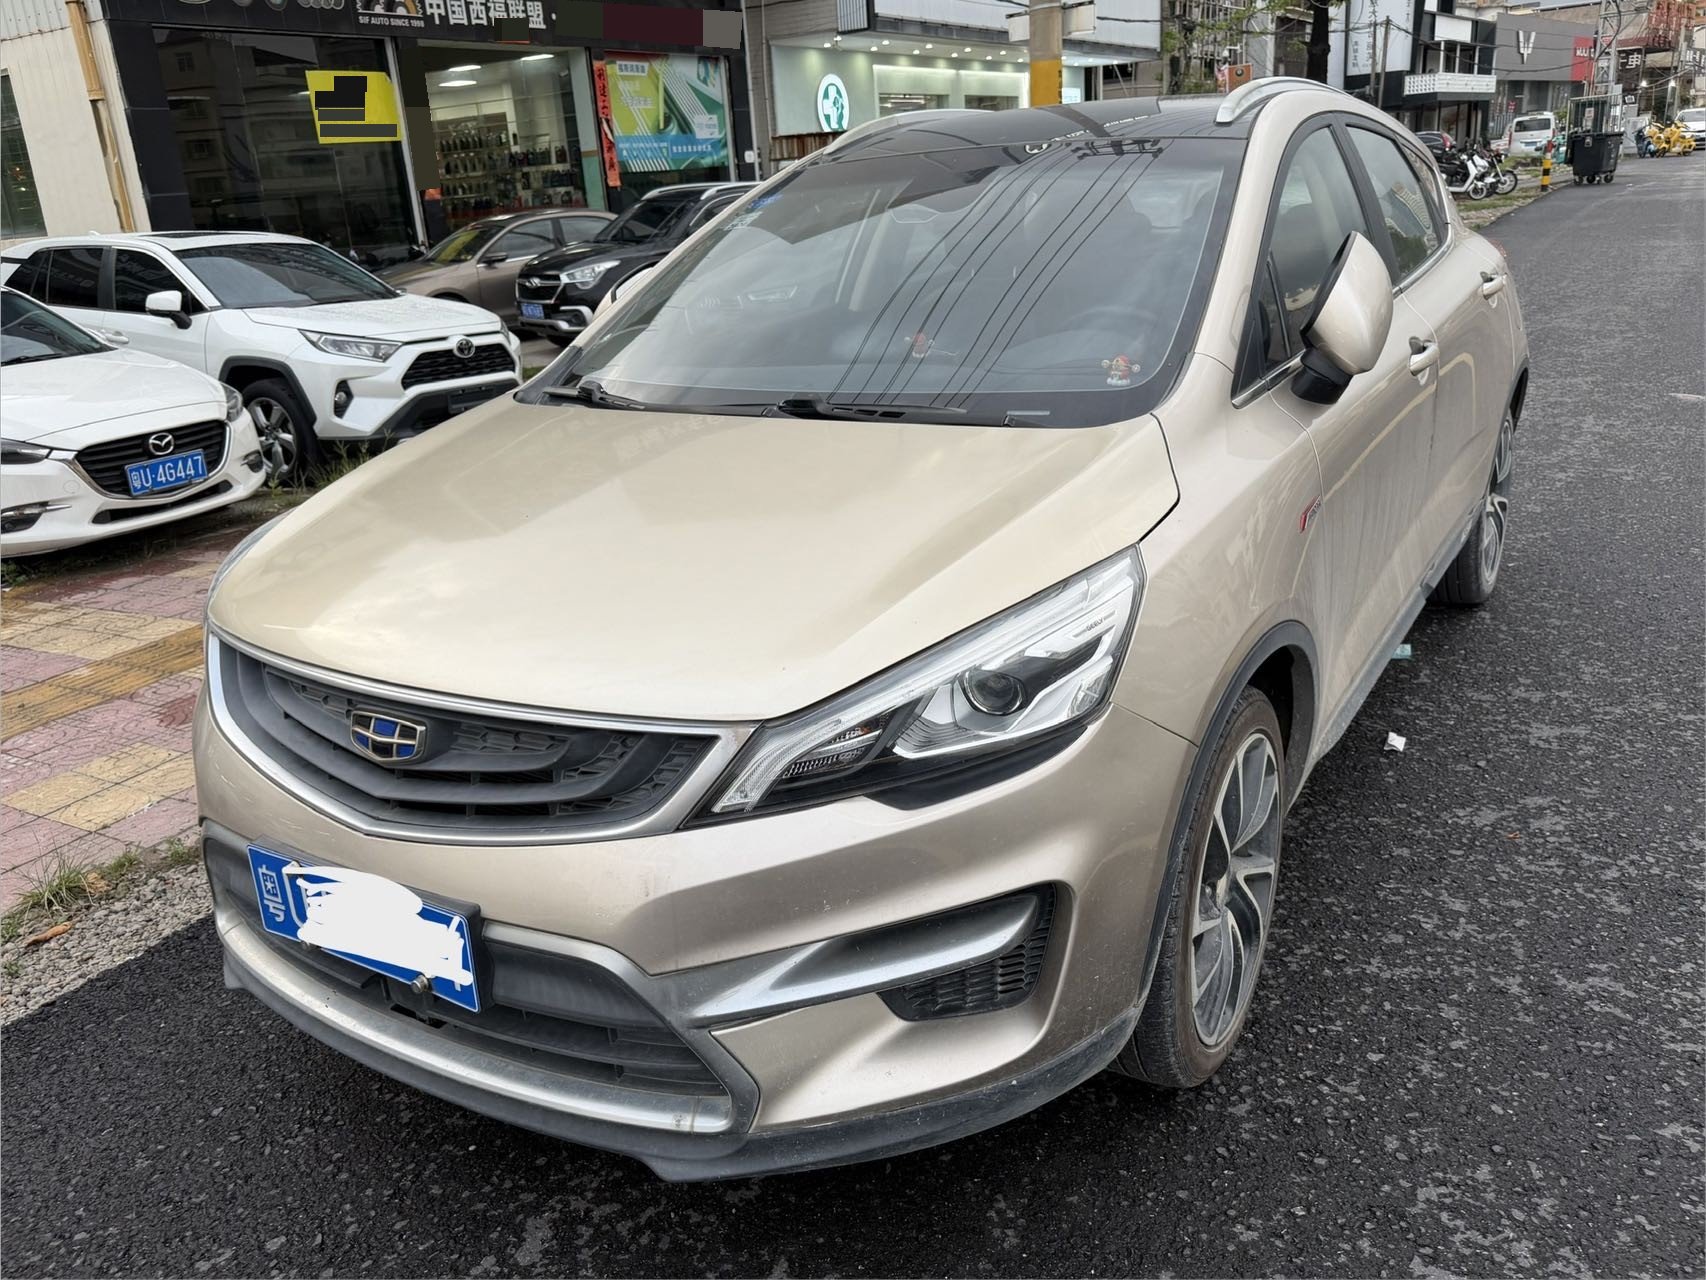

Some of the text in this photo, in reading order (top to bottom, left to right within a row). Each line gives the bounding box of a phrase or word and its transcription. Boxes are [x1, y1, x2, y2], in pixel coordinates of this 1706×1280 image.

[358, 15, 370, 24] SIF
[371, 16, 389, 25] AUTO
[390, 18, 410, 27] SINCE
